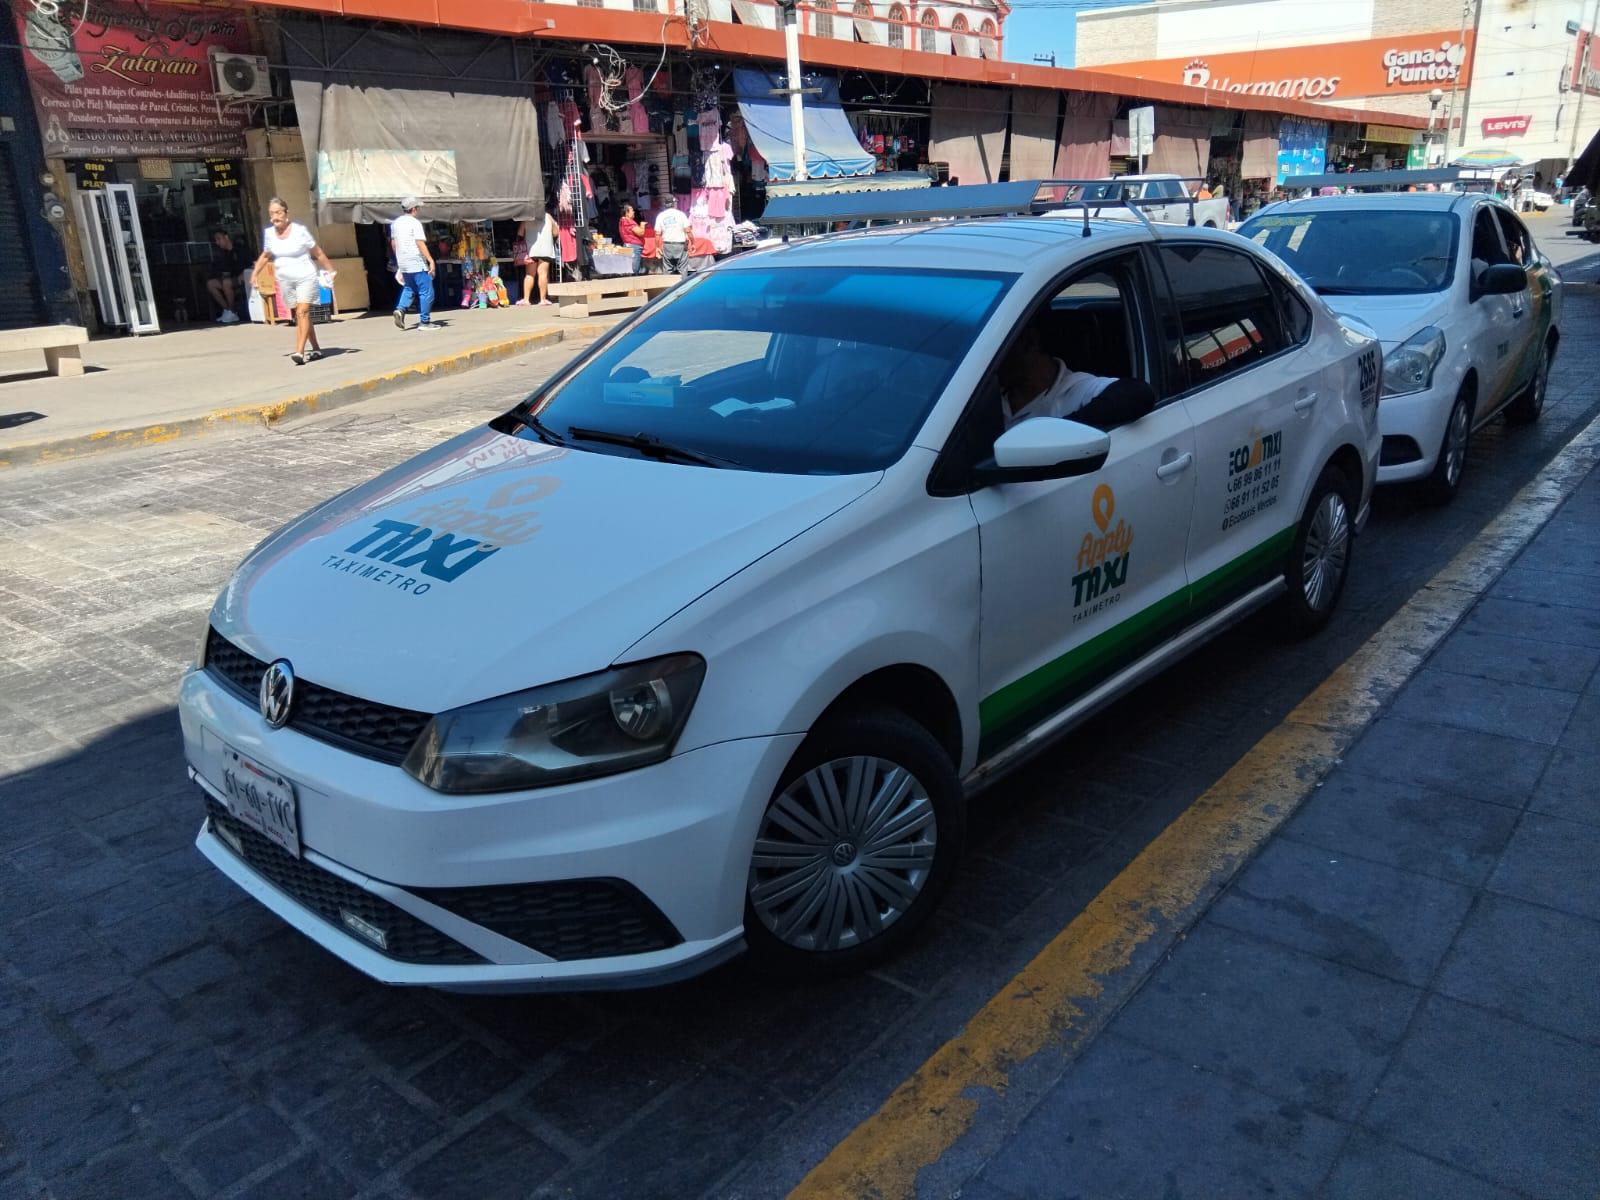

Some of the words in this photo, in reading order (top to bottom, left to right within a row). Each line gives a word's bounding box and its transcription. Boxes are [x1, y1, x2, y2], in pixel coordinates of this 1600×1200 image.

[90, 43, 199, 86] Zatarain
[1383, 49, 1435, 67] Gana
[1388, 63, 1458, 84] Puntos
[344, 518, 502, 583] TAXI
[321, 554, 432, 596] TAXIMETRO
[1072, 551, 1130, 608] TAXI
[1072, 593, 1121, 624] TAXIMETRO
